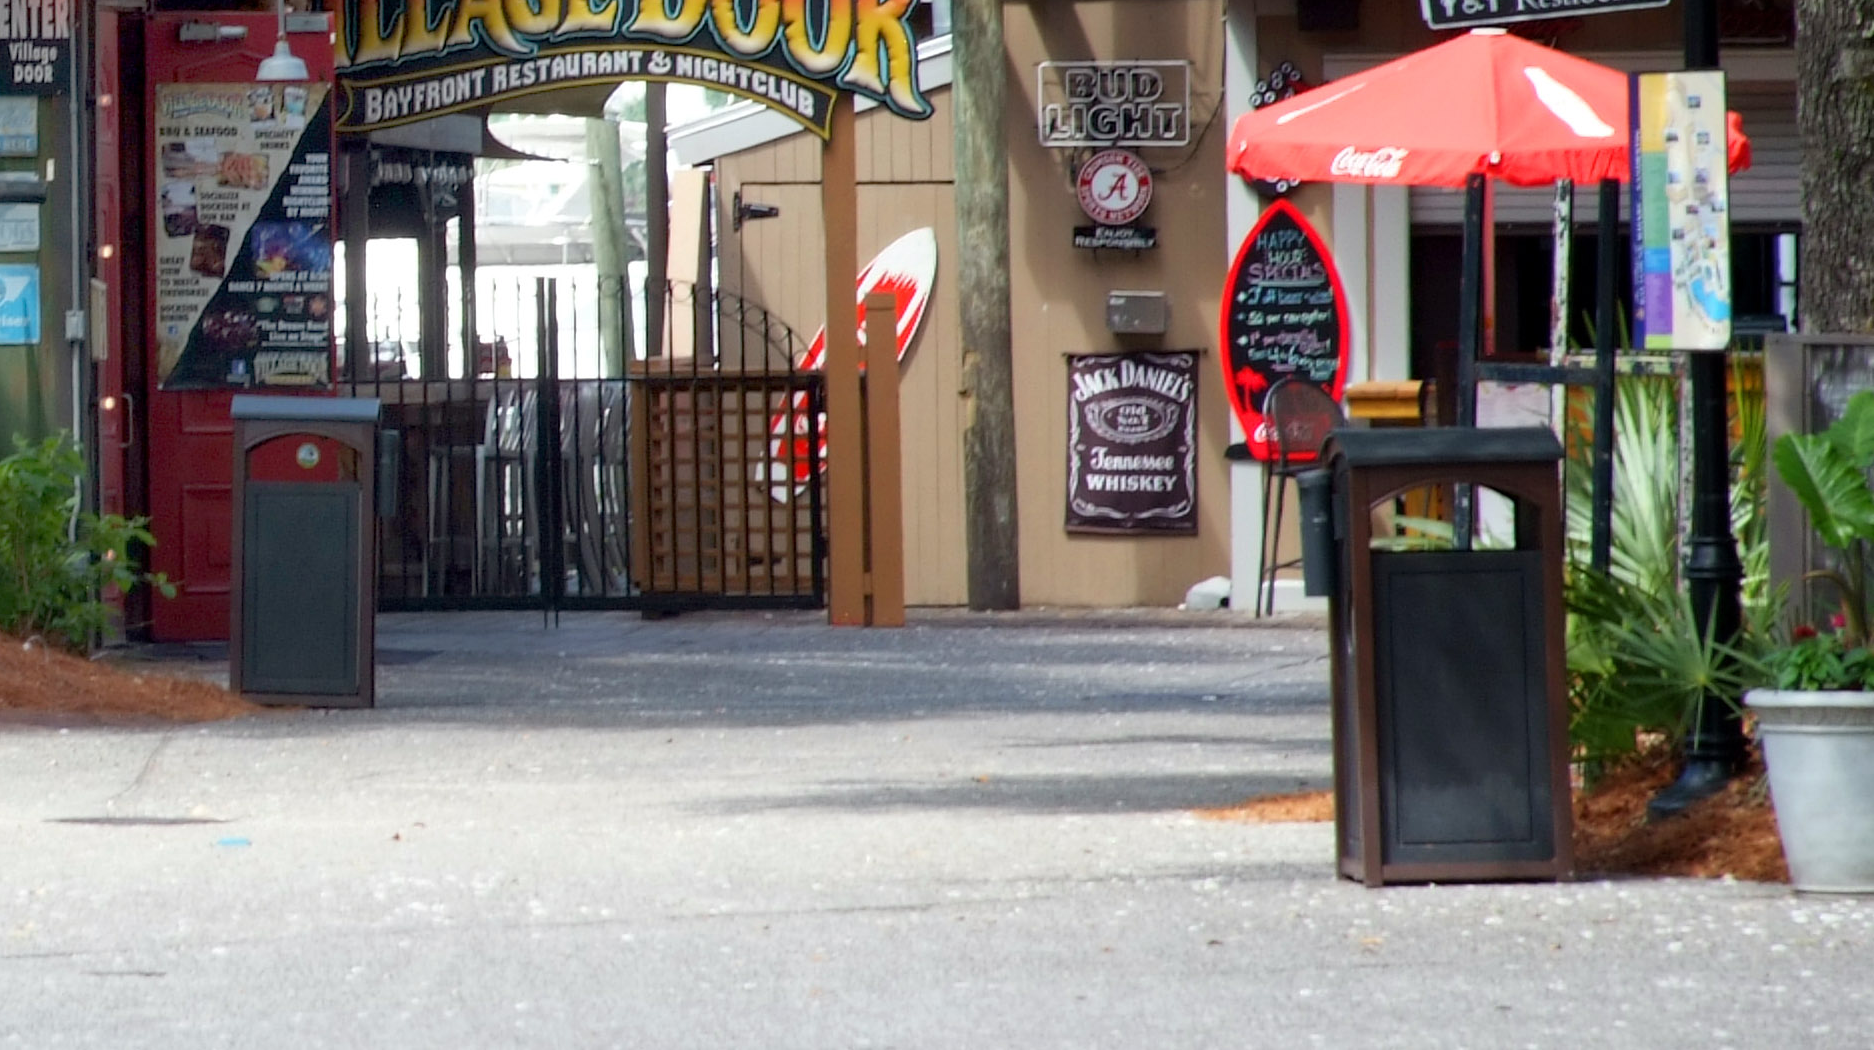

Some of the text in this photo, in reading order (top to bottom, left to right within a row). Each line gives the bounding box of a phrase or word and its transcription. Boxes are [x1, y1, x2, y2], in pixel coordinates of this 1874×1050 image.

[9, 42, 58, 66] Village
[13, 64, 54, 83] DOOR
[365, 51, 816, 123] BAYFRONT RESTAURANT & NIGHTCLUB
[1066, 68, 1163, 103] BUD
[1045, 103, 1182, 140] LIGHT
[1098, 172, 1128, 201] A
[1073, 359, 1193, 403] JACK DANIEL'S
[1090, 446, 1175, 470] Tennessee
[1086, 473, 1178, 492] WHISKEY
